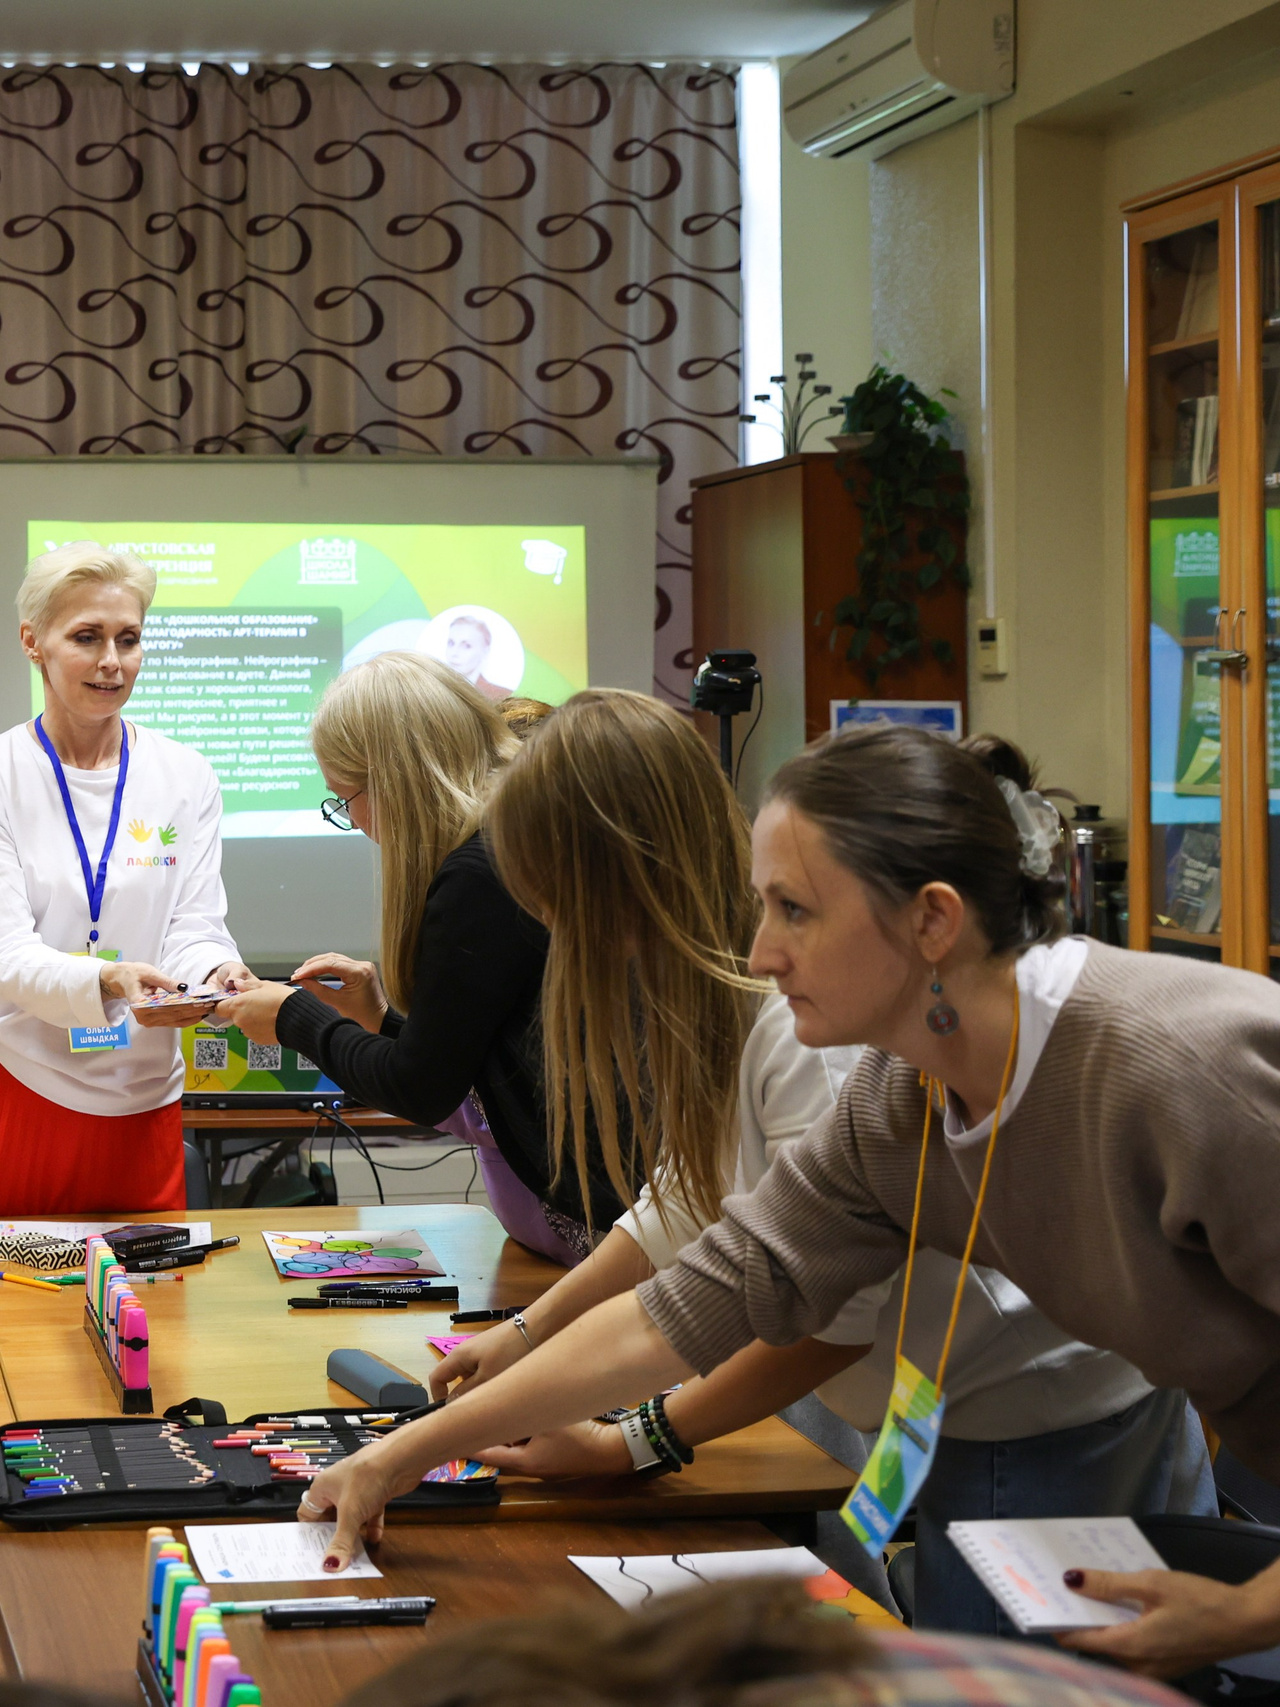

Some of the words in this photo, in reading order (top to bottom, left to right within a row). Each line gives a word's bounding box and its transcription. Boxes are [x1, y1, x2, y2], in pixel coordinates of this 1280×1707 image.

[149, 560, 212, 573] ЕРЕНЦИЯ
[144, 615, 162, 625] РЕК
[164, 615, 240, 626] «ДОШКОЛЬНОЕ
[242, 615, 318, 625] ОБРАЗОВАНИЕ»
[233, 628, 298, 637] АРТ-ТЕРАПИЯ
[299, 628, 307, 637] В
[140, 640, 183, 651] ДАГОГУ»
[148, 658, 161, 666] по
[164, 656, 242, 668] Нейрографике.
[244, 655, 318, 668] Нейрографика
[169, 672, 225, 682] рисование
[269, 669, 311, 682] Данный
[145, 686, 164, 694] как
[166, 686, 194, 694] сеанс
[206, 685, 256, 696] хорошего
[258, 684, 312, 695] психолога,
[164, 699, 226, 710] интереснее,
[228, 699, 278, 709] приятнее
[157, 713, 175, 722] Мы
[178, 714, 218, 724] рисуем,
[239, 713, 260, 722] этот
[262, 713, 301, 721] момент
[177, 726, 236, 738] нейронные
[243, 740, 266, 751] пути
[232, 766, 318, 778] «Благодарность»
[242, 781, 300, 793] ресурсного
[86, 1026, 112, 1034] ОЛЬГА
[80, 1034, 120, 1044] ШВЫДКАЯ
